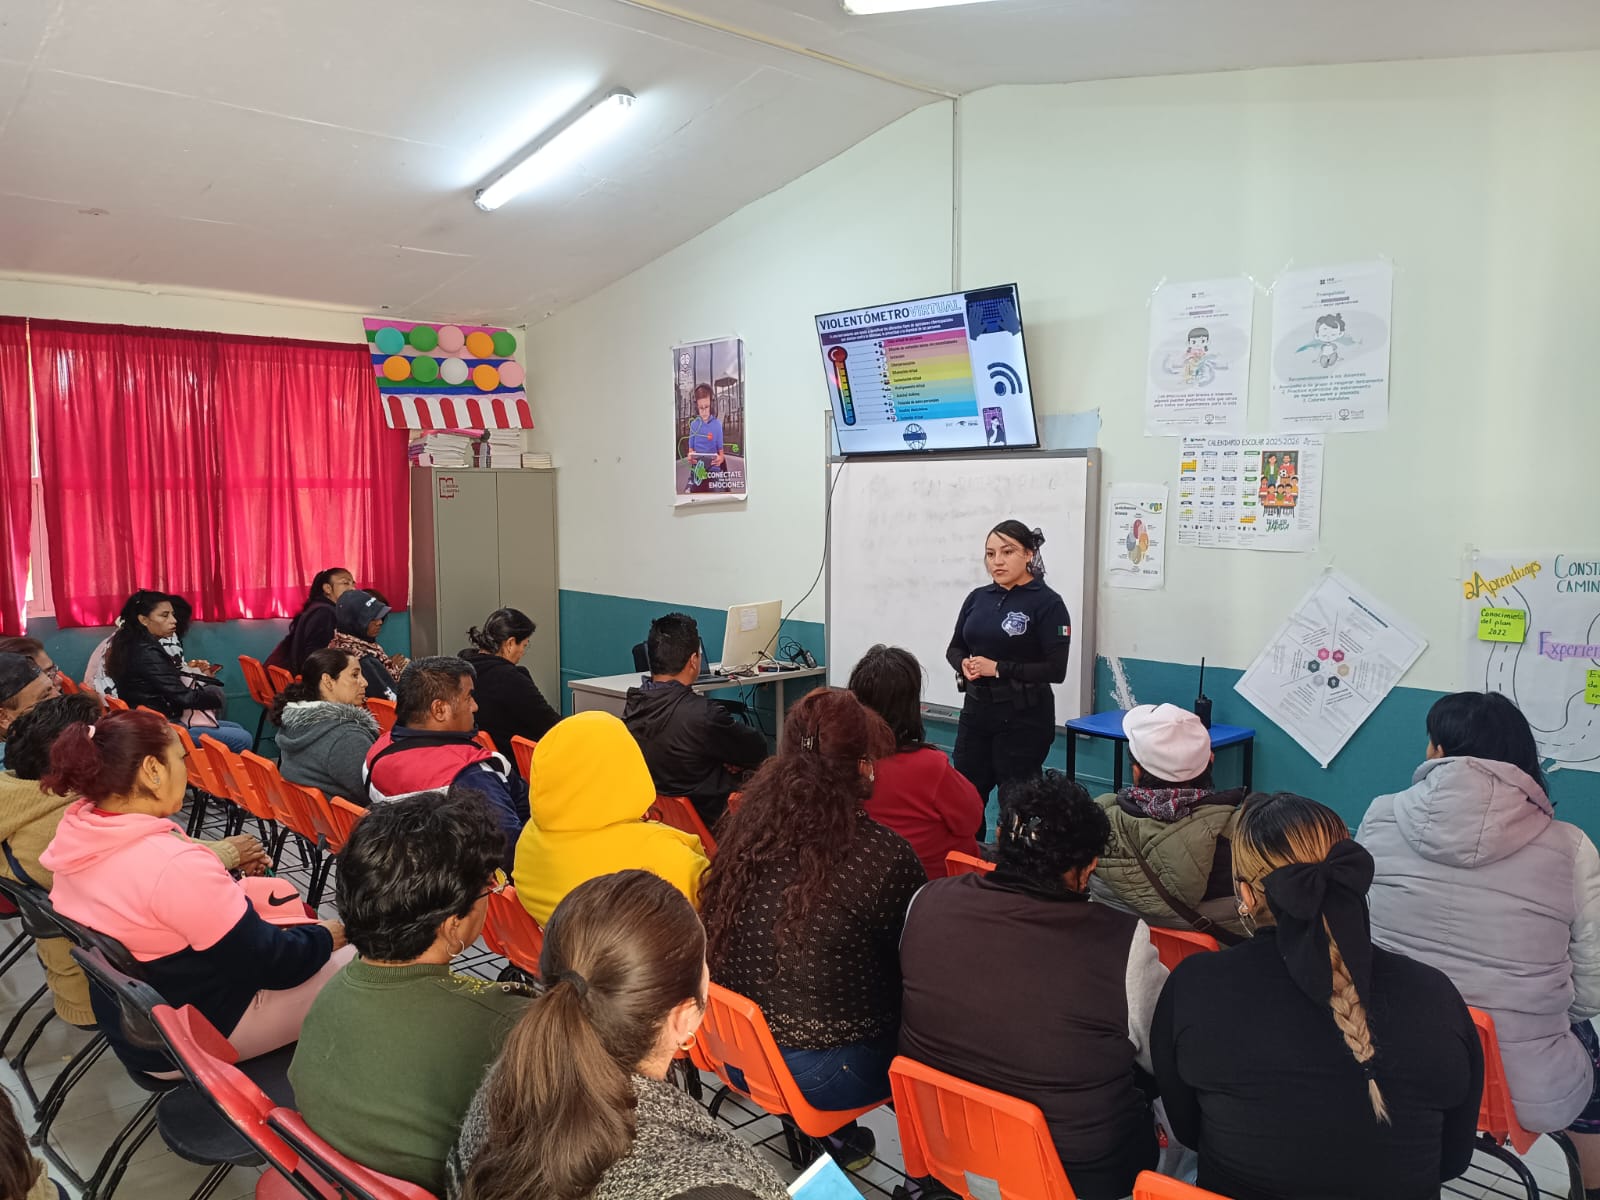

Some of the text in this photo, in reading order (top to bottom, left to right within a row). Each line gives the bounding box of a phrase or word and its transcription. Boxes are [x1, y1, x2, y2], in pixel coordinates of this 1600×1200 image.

[820, 308, 910, 330] VIOLENTÓMETRO
[909, 300, 962, 317] VIRTUAL
[708, 481, 745, 489] EMOCIONES
[1554, 554, 1600, 579] CONST
[1488, 628, 1507, 636] 2022
